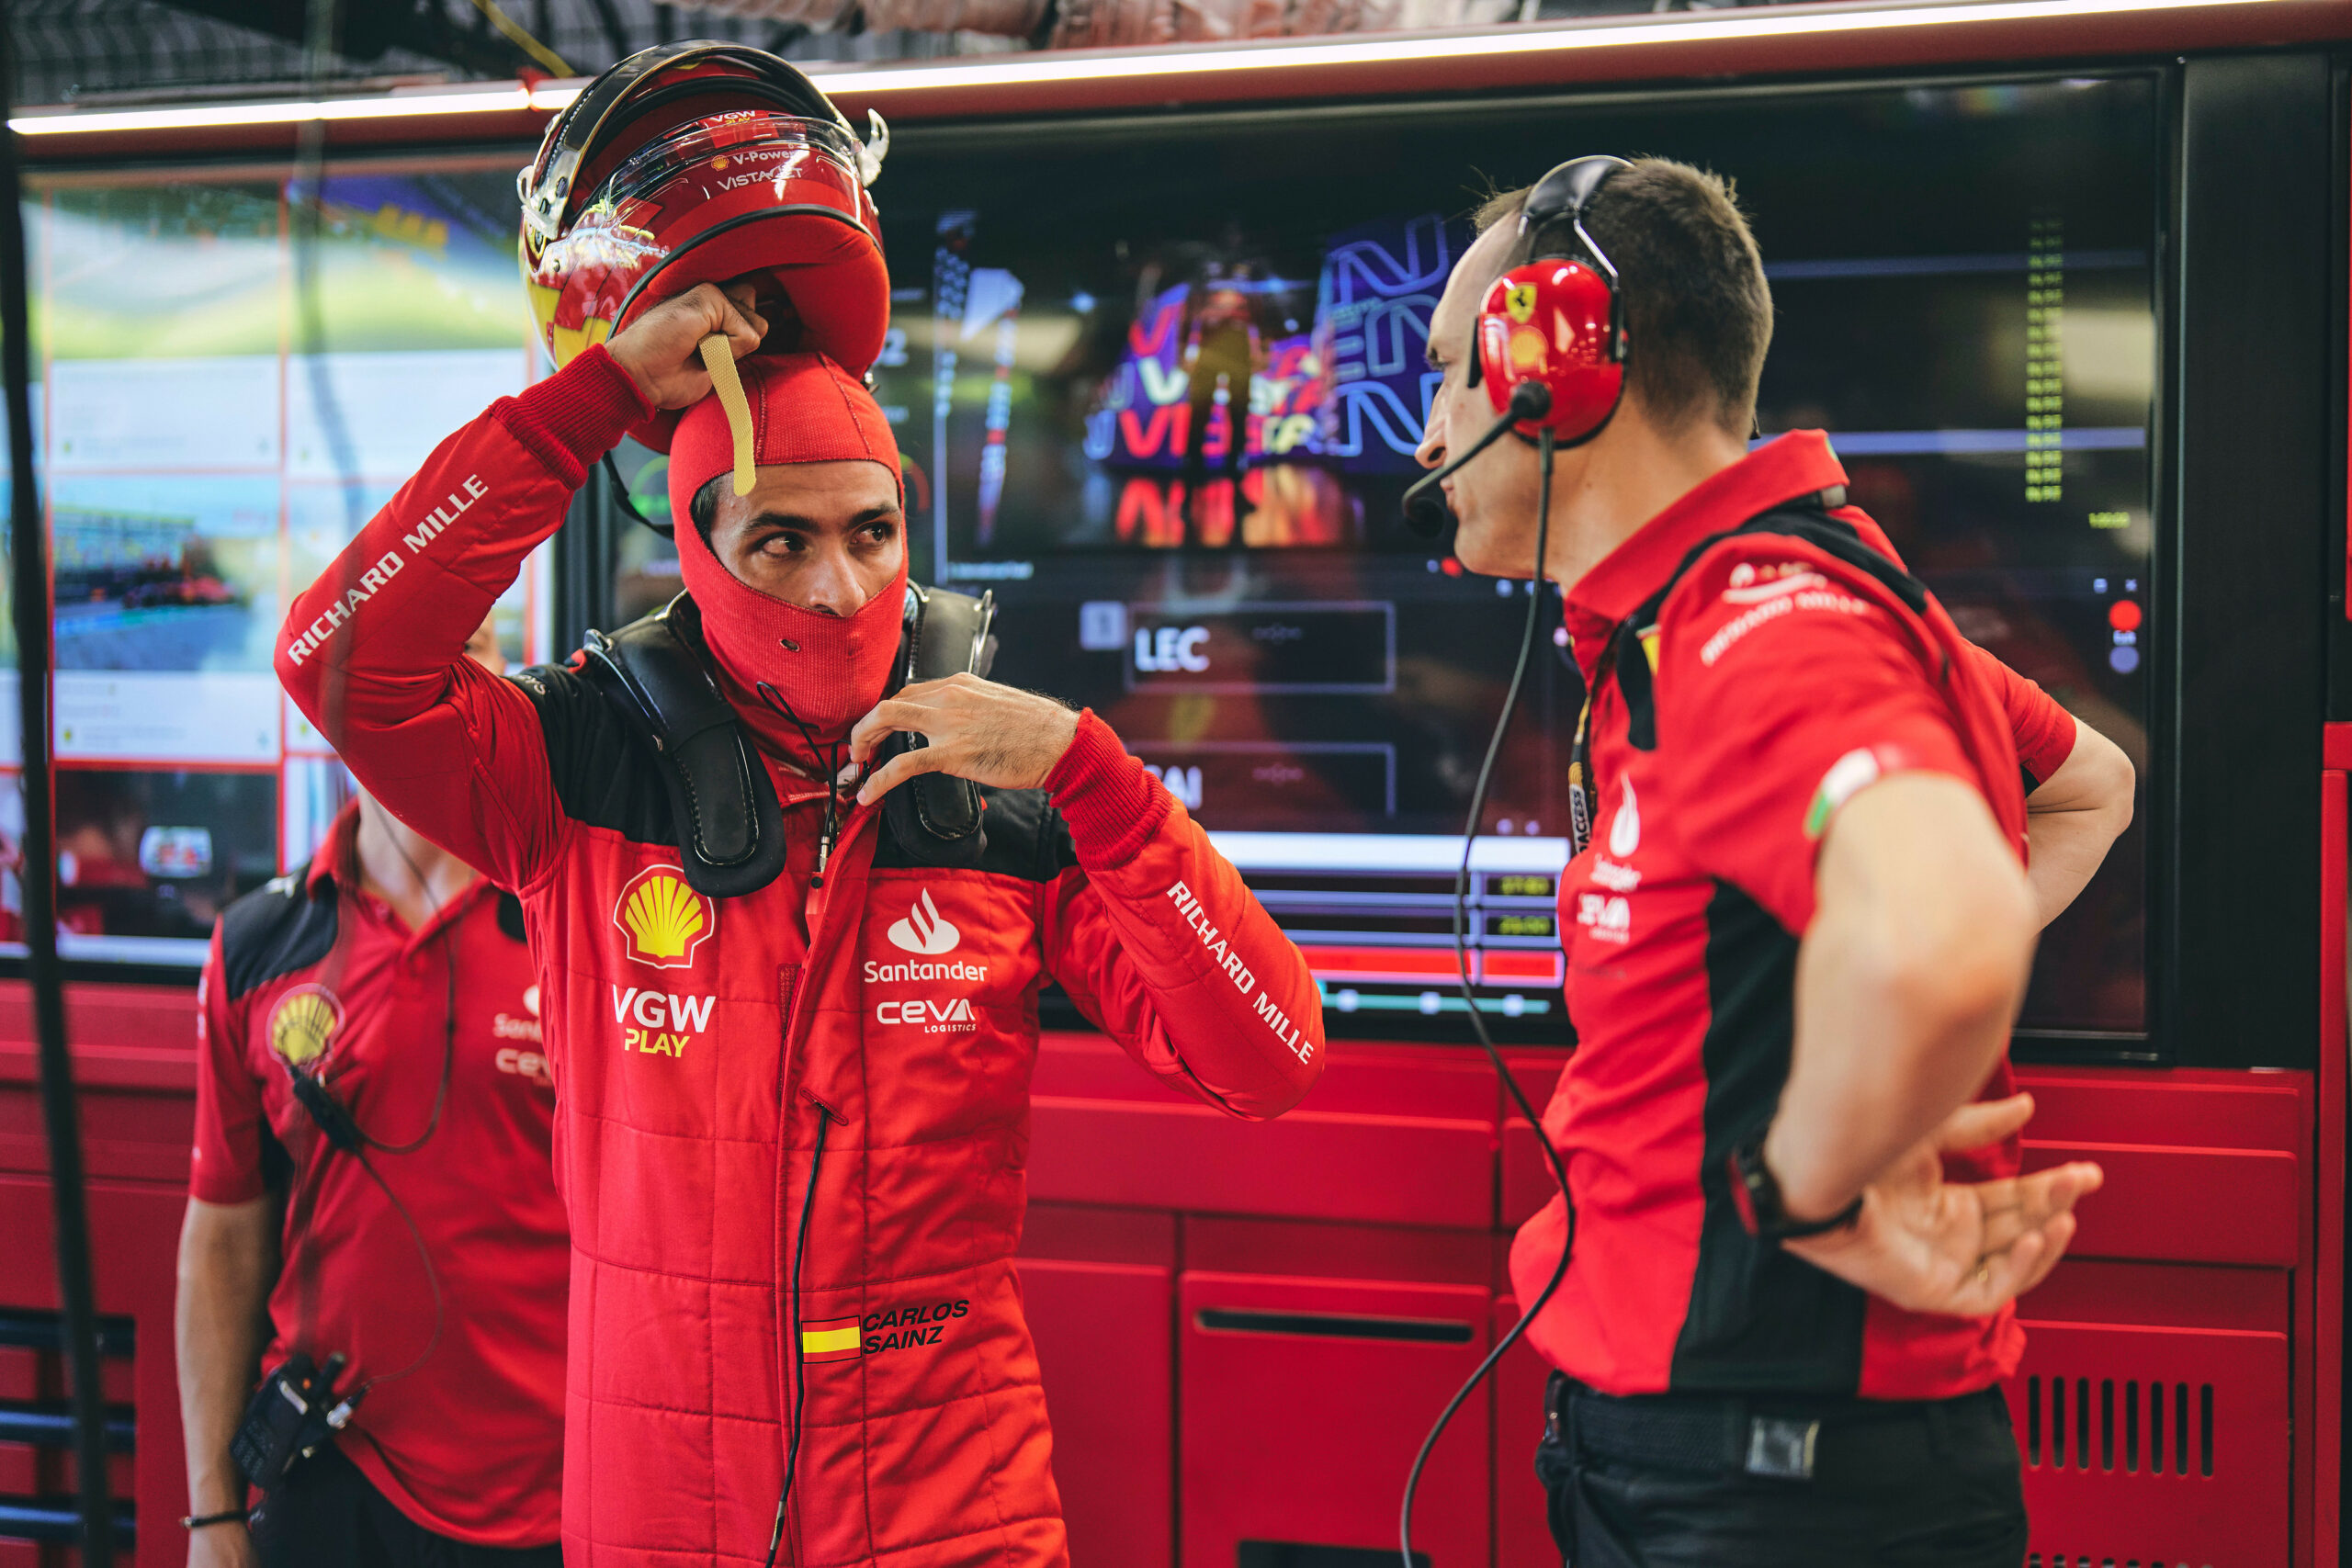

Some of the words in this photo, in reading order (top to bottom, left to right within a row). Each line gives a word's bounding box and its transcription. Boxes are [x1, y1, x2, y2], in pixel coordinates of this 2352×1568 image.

[708, 110, 756, 122] VGW
[717, 165, 803, 191] VISTAJT
[288, 551, 404, 667] RICHARD
[402, 474, 490, 554] MILLE
[1135, 626, 1210, 672] LEC
[864, 959, 988, 984] Santander
[1166, 879, 1256, 995] RICHARD
[1252, 990, 1314, 1065] MILLE
[612, 984, 717, 1033] VGW
[924, 1022, 977, 1033] LOGISTICS
[624, 1028, 690, 1057] PLAY
[862, 1299, 970, 1333] CARLOS
[863, 1325, 944, 1354] SAINZ
